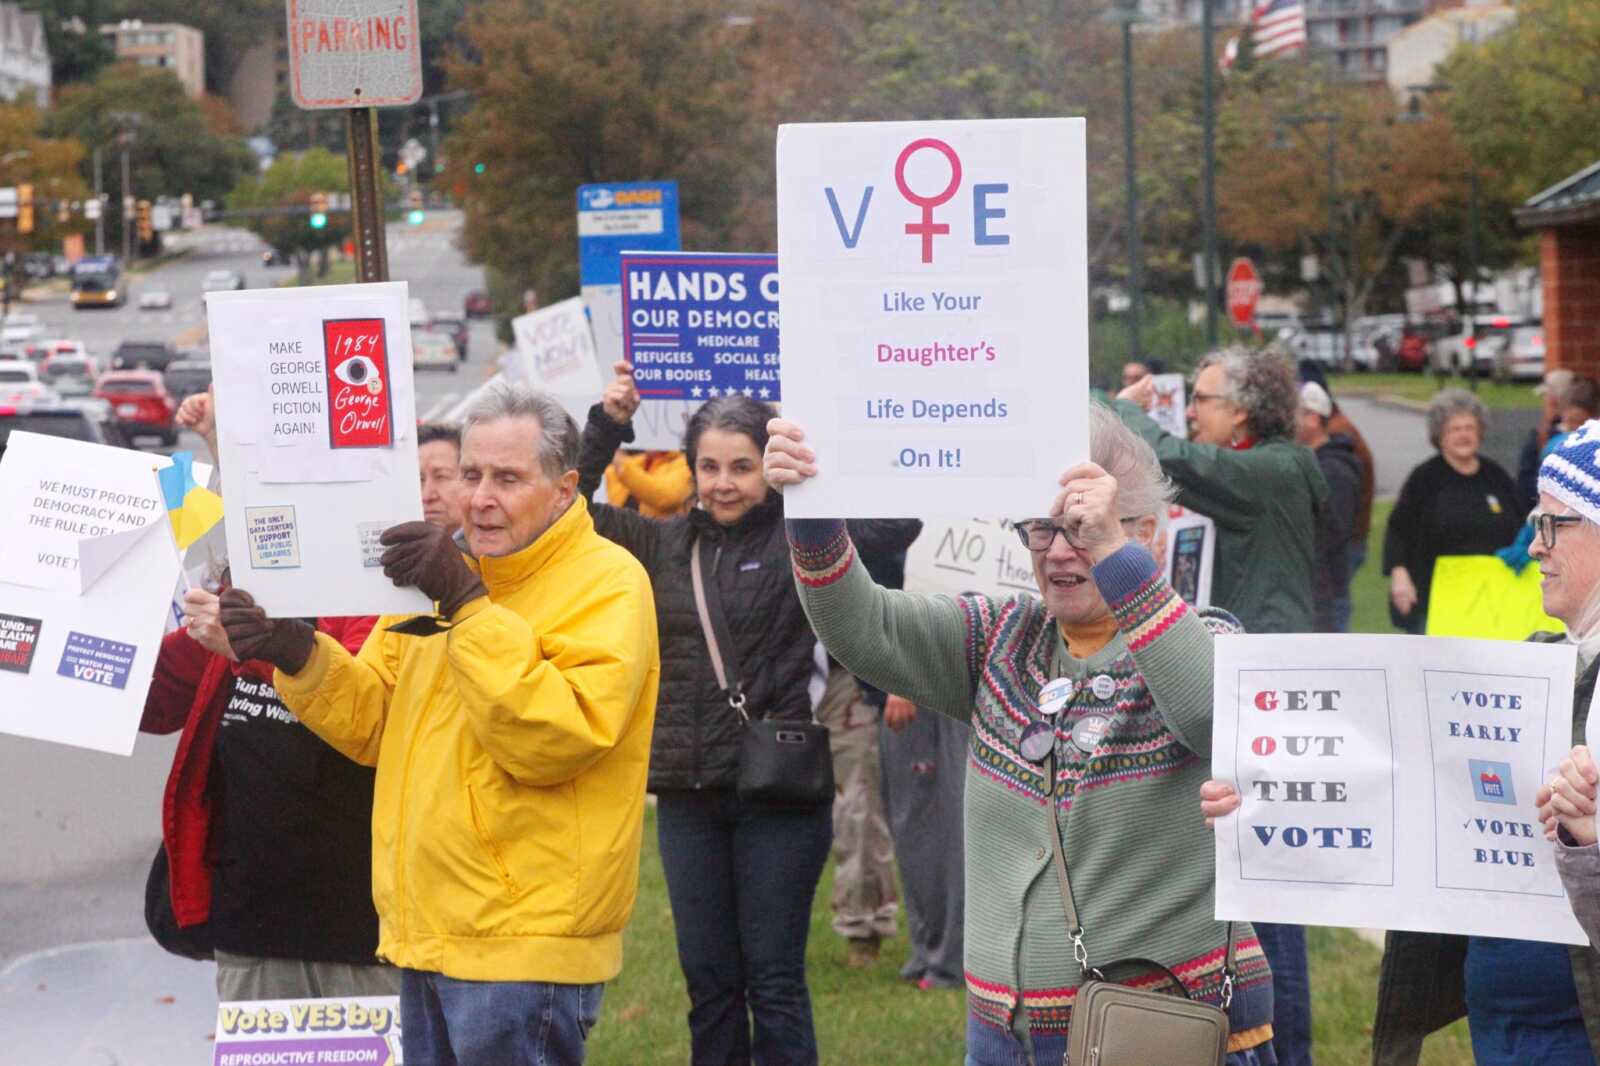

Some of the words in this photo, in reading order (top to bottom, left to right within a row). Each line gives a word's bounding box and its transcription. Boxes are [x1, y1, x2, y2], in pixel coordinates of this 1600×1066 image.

[302, 15, 407, 53] PARKING
[630, 271, 748, 302] HANDS
[882, 292, 925, 312] Like
[932, 292, 981, 312] Your
[632, 309, 680, 328] OUR
[687, 310, 780, 330] DEMOCR
[269, 341, 303, 355] MAKE
[333, 334, 380, 356] 1984
[697, 335, 761, 348] MEDICARE
[270, 360, 322, 375] GEORGE
[634, 351, 695, 364] REFUGEES
[713, 352, 761, 365] SOCIAL
[633, 369, 662, 381] OUR
[665, 369, 713, 382] BODIES
[271, 380, 323, 395] ORWELL
[272, 400, 321, 416] FICTION
[334, 386, 380, 417] George
[866, 398, 905, 419] Life
[911, 398, 1008, 423] Depends
[273, 421, 316, 436] AGAIN!
[340, 410, 386, 436] Orwell
[899, 447, 931, 468] On
[937, 448, 962, 468] It!
[39, 479, 61, 493] WE
[61, 483, 97, 499] MUST
[98, 489, 159, 511] PROTECT
[32, 496, 116, 521] DEMOCRACY
[116, 511, 147, 527] AND
[254, 517, 266, 526] THE
[29, 513, 53, 529] THE
[54, 518, 89, 535] RULE
[258, 531, 291, 543] SUPPORT
[934, 527, 986, 563] NO
[37, 551, 73, 569] VOTE
[0, 618, 25, 632] UND
[0, 629, 36, 644] EALTH
[0, 639, 18, 651] ARE
[66, 644, 95, 657] PROTECT
[73, 664, 115, 685] VOTE
[1254, 690, 1342, 712] GET
[1461, 690, 1523, 711] VOTE
[265, 703, 296, 724] Wag
[1448, 721, 1522, 744] EARLY
[1251, 735, 1344, 758] OUT
[1252, 780, 1348, 803] THE
[1483, 782, 1502, 797] VOTE
[1251, 825, 1374, 850] VOTE
[1474, 818, 1535, 838] VOTE
[1474, 848, 1536, 868] BLUE
[220, 1006, 289, 1035] Vote
[289, 1001, 347, 1033] YES
[346, 1000, 394, 1035] by
[219, 1050, 314, 1066] REPRODUCTIVE
[316, 1048, 379, 1062] FREEDOM
